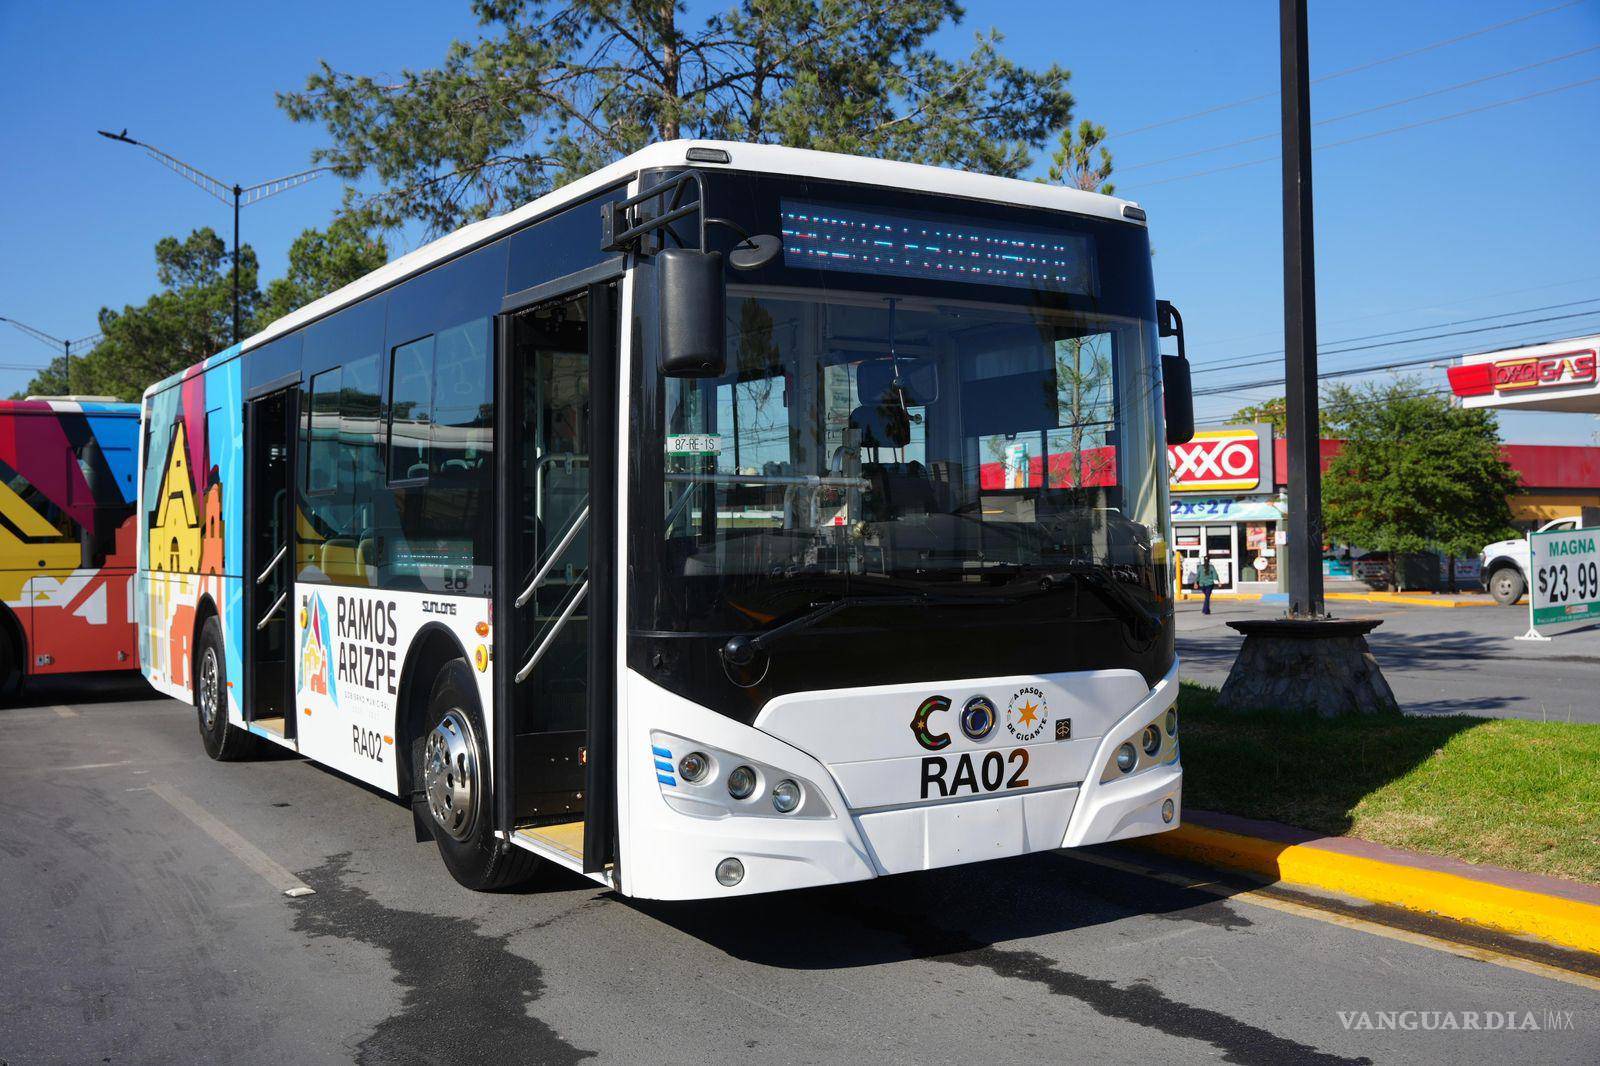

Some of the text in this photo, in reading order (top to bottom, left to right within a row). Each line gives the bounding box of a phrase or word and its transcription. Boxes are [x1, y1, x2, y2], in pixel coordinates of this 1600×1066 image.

[1496, 356, 1593, 384] OXXO GAS
[1168, 438, 1254, 478] XXO
[1549, 538, 1595, 557] MAGNA
[1539, 562, 1598, 603] $23.99
[337, 596, 398, 647] RAMOS
[338, 641, 397, 696] ARIZPE
[1019, 686, 1044, 699] PASOS
[353, 723, 384, 763] RA02
[1006, 717, 1048, 742] DE GIGANTE
[919, 747, 1030, 799] RA02
